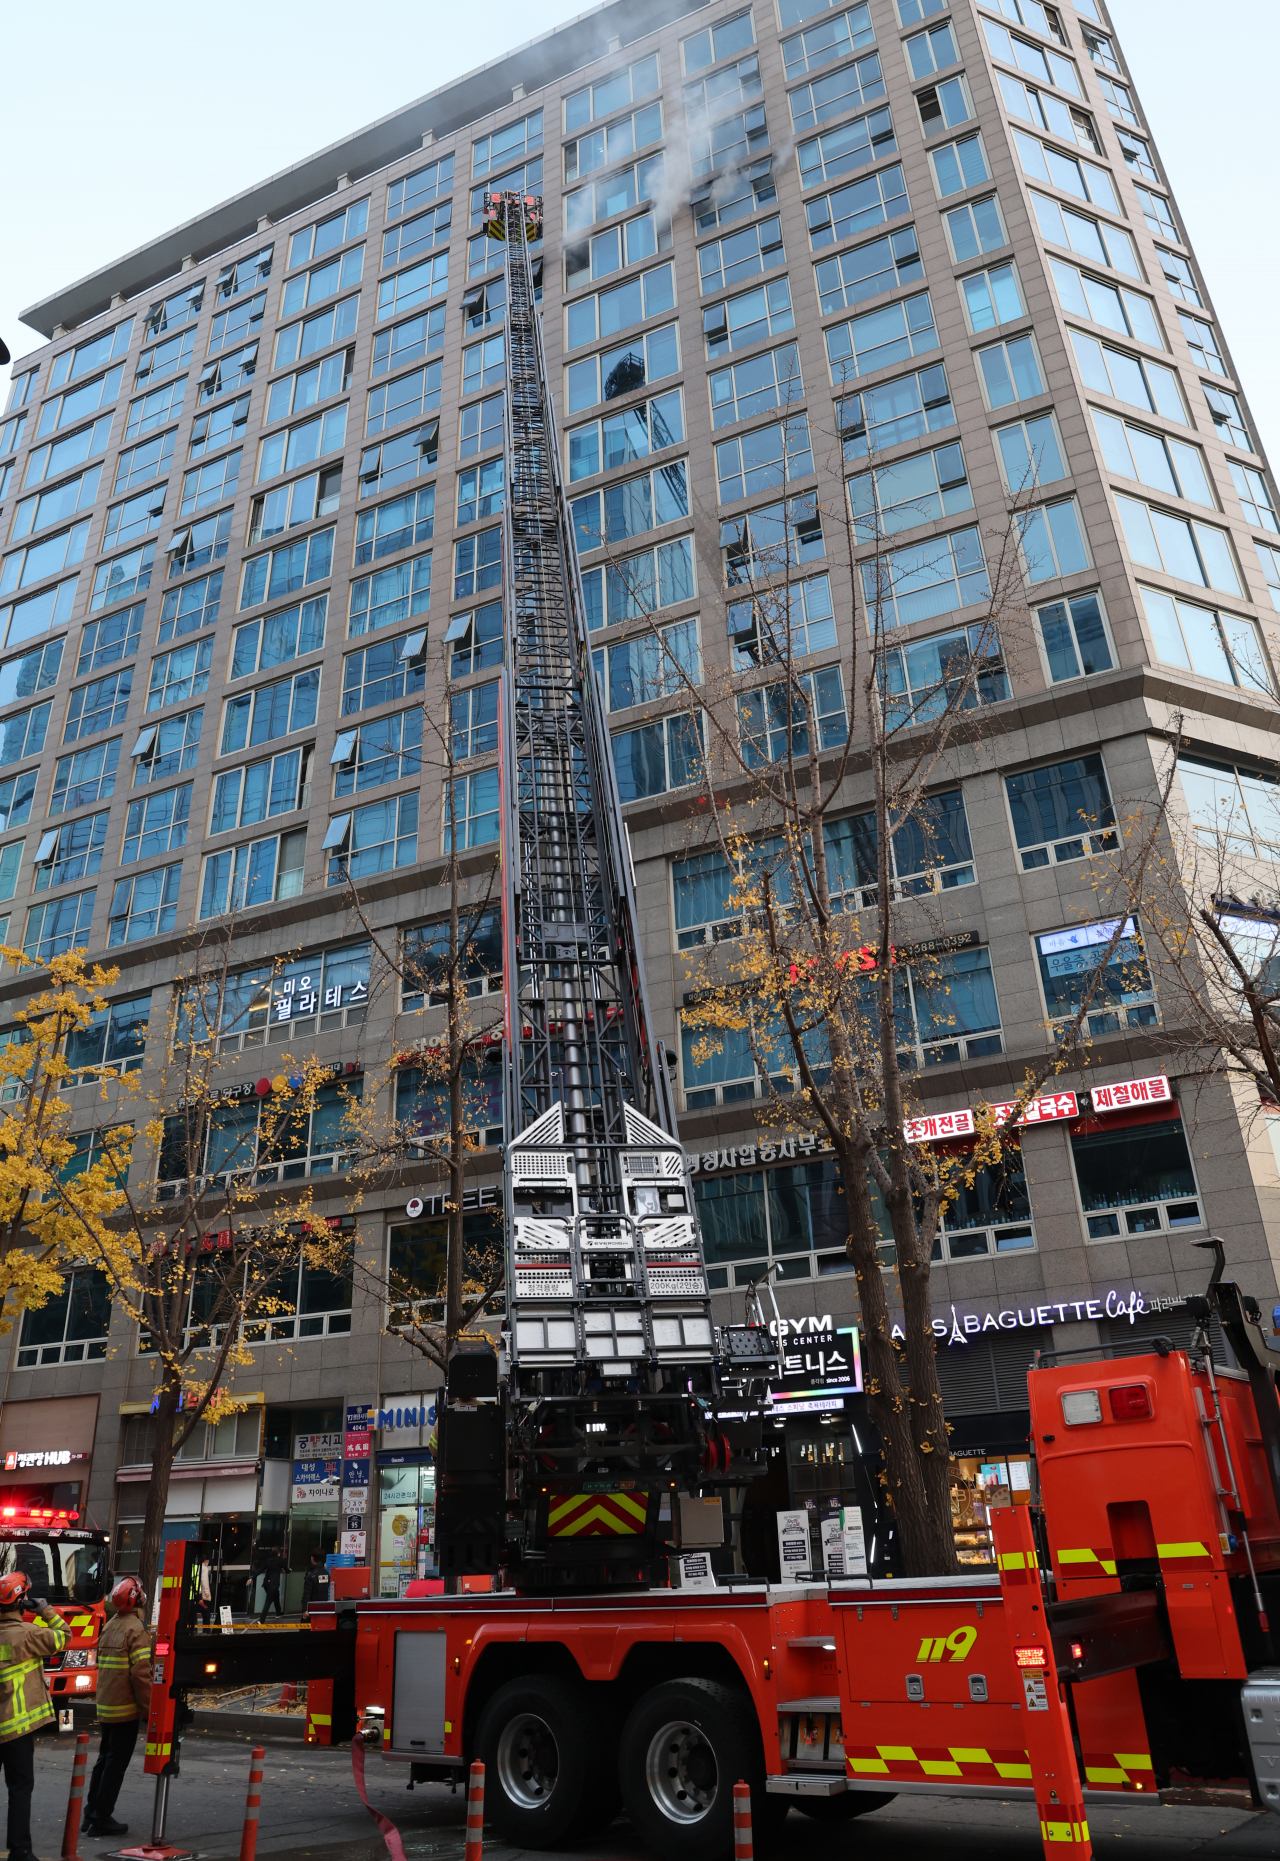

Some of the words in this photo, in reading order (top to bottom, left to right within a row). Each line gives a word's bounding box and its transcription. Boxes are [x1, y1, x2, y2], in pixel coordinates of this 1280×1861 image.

[1049, 938, 1065, 948] 마음
[1089, 942, 1138, 965] 공장애
[283, 975, 312, 995] 미오
[276, 980, 367, 1020] 필라테스
[223, 1082, 253, 1100] 당구장
[1095, 1078, 1166, 1108] 제철해물
[907, 1113, 969, 1139] 조개전골
[992, 1095, 1075, 1127] 조칼국수
[527, 1283, 559, 1292] 정격용량
[963, 1299, 1101, 1335] BAGUETTE
[1105, 1290, 1151, 1324] Café
[770, 1315, 832, 1336] GYM
[793, 1334, 833, 1346] CENTER
[778, 1350, 849, 1379] 트니스
[301, 1464, 316, 1472] 대성
[309, 1488, 334, 1497] 차이나로
[351, 1521, 359, 1529] 95
[916, 1625, 978, 1663] 119
